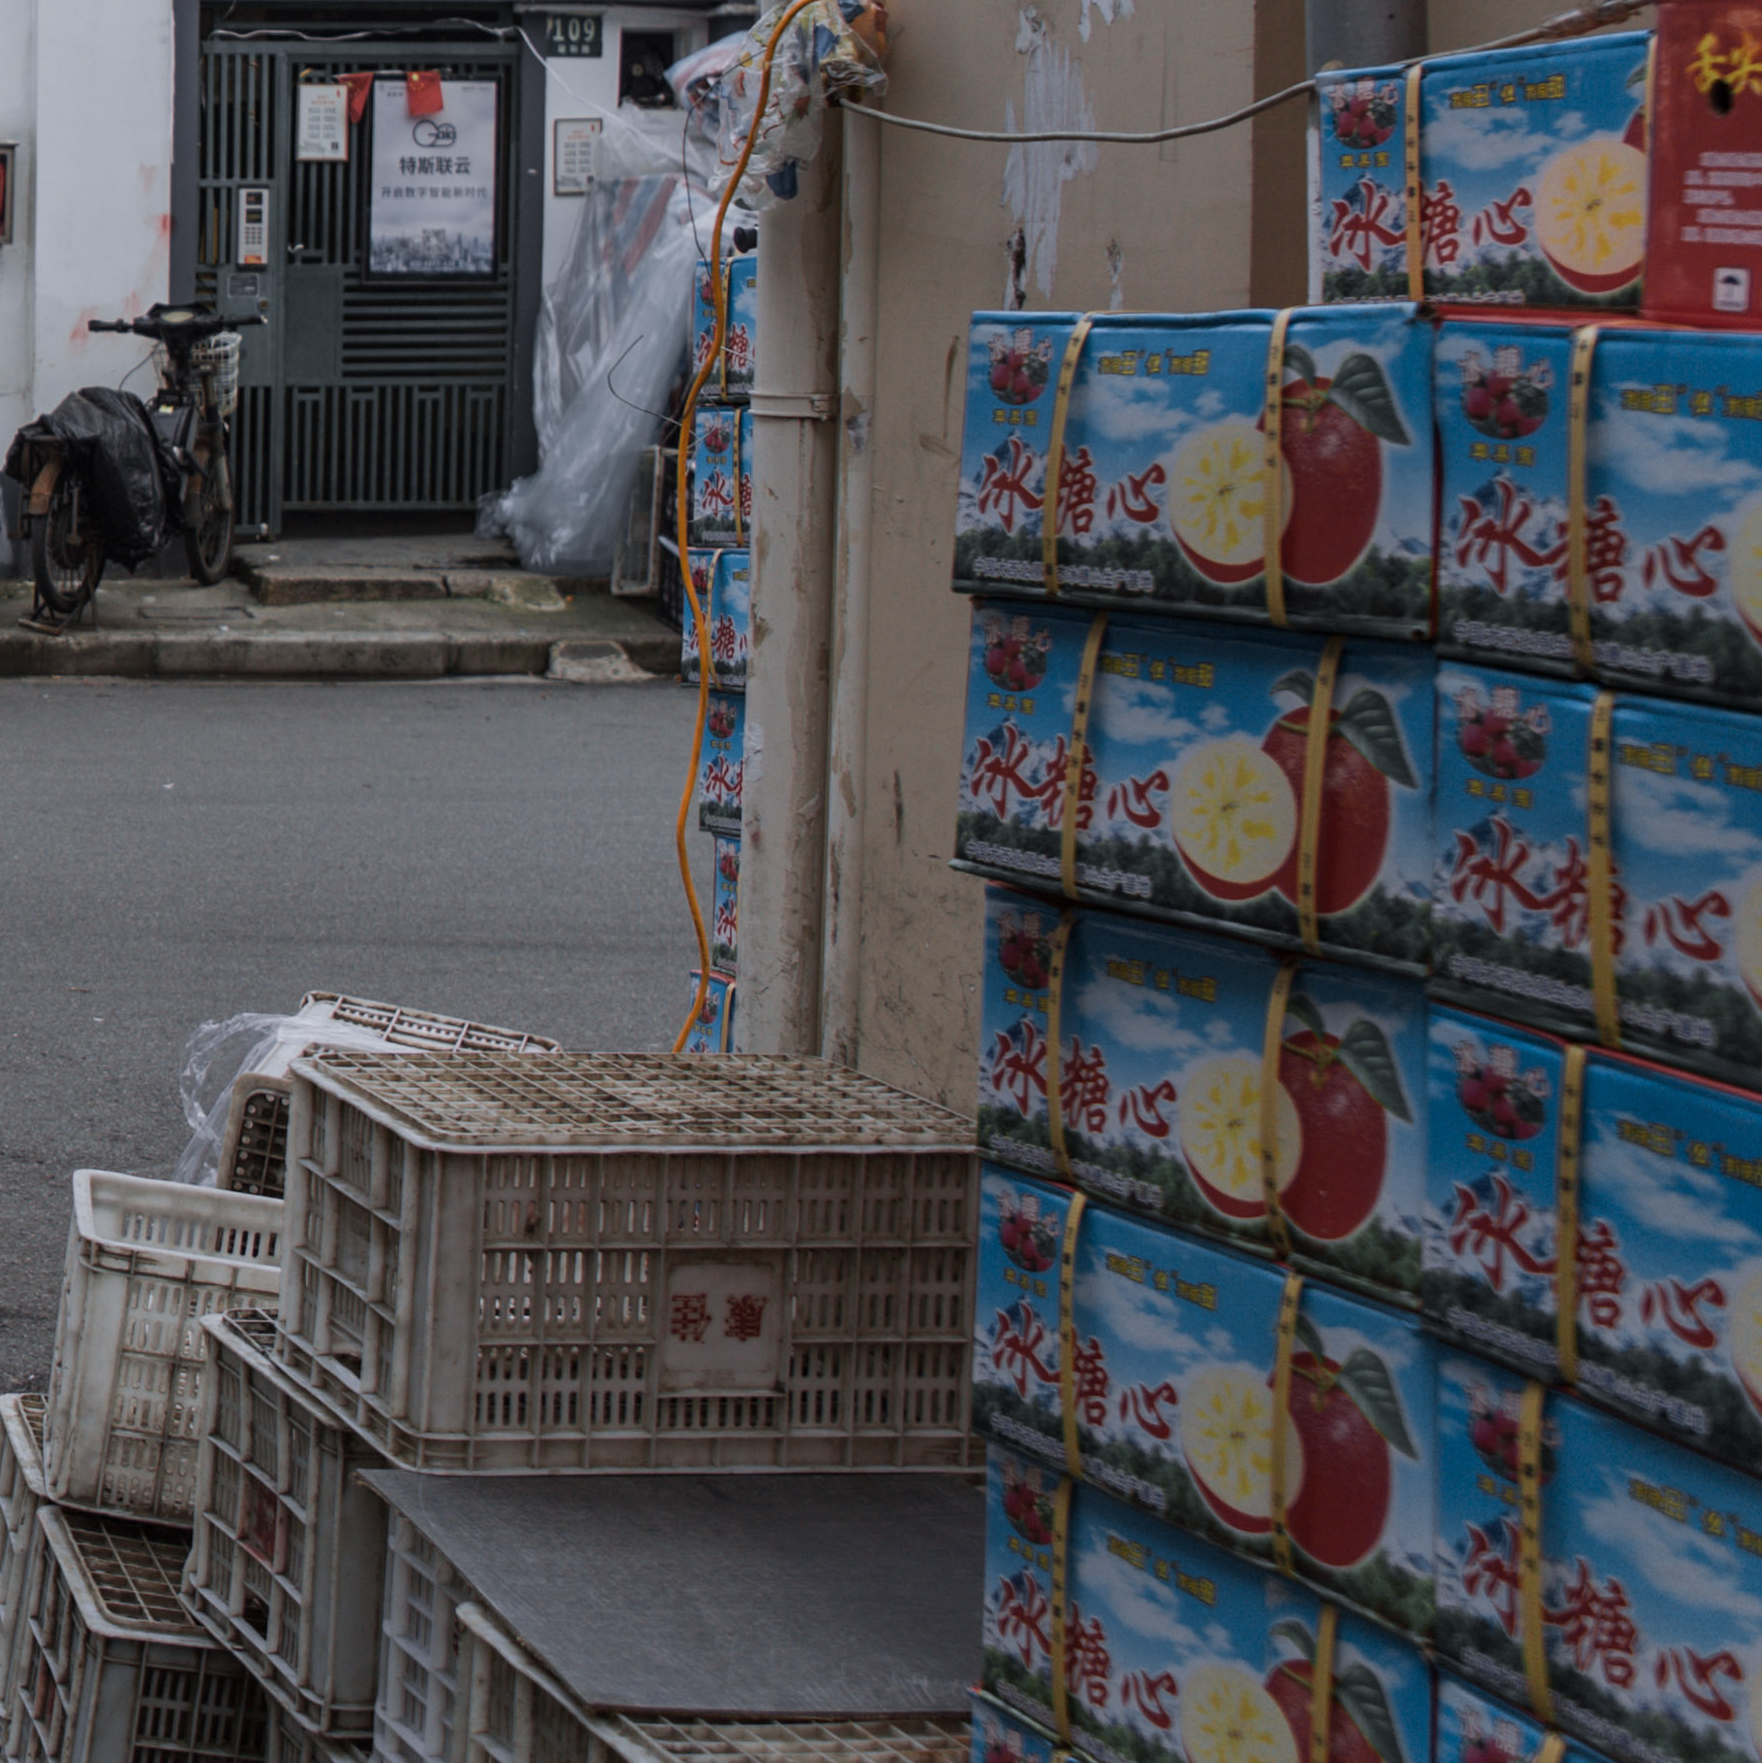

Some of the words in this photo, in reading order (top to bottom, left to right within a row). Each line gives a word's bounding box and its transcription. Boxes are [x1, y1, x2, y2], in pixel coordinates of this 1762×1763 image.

[552, 17, 595, 43] 109
[399, 156, 471, 175] 特斯联云
[1330, 178, 1532, 272] 冰糖心
[978, 438, 1165, 535] 冰糖心
[1456, 478, 1724, 603] 冰糖心
[970, 724, 1169, 829] 冰糖心
[1451, 815, 1731, 961] 冰糖心
[992, 1021, 1177, 1138] 冰糖心
[1452, 1174, 1725, 1348] 冰糖心
[993, 1301, 1177, 1439] 冰糖心
[998, 1570, 1177, 1729] 冰糖心
[1463, 1519, 1742, 1721] 冰糖心
